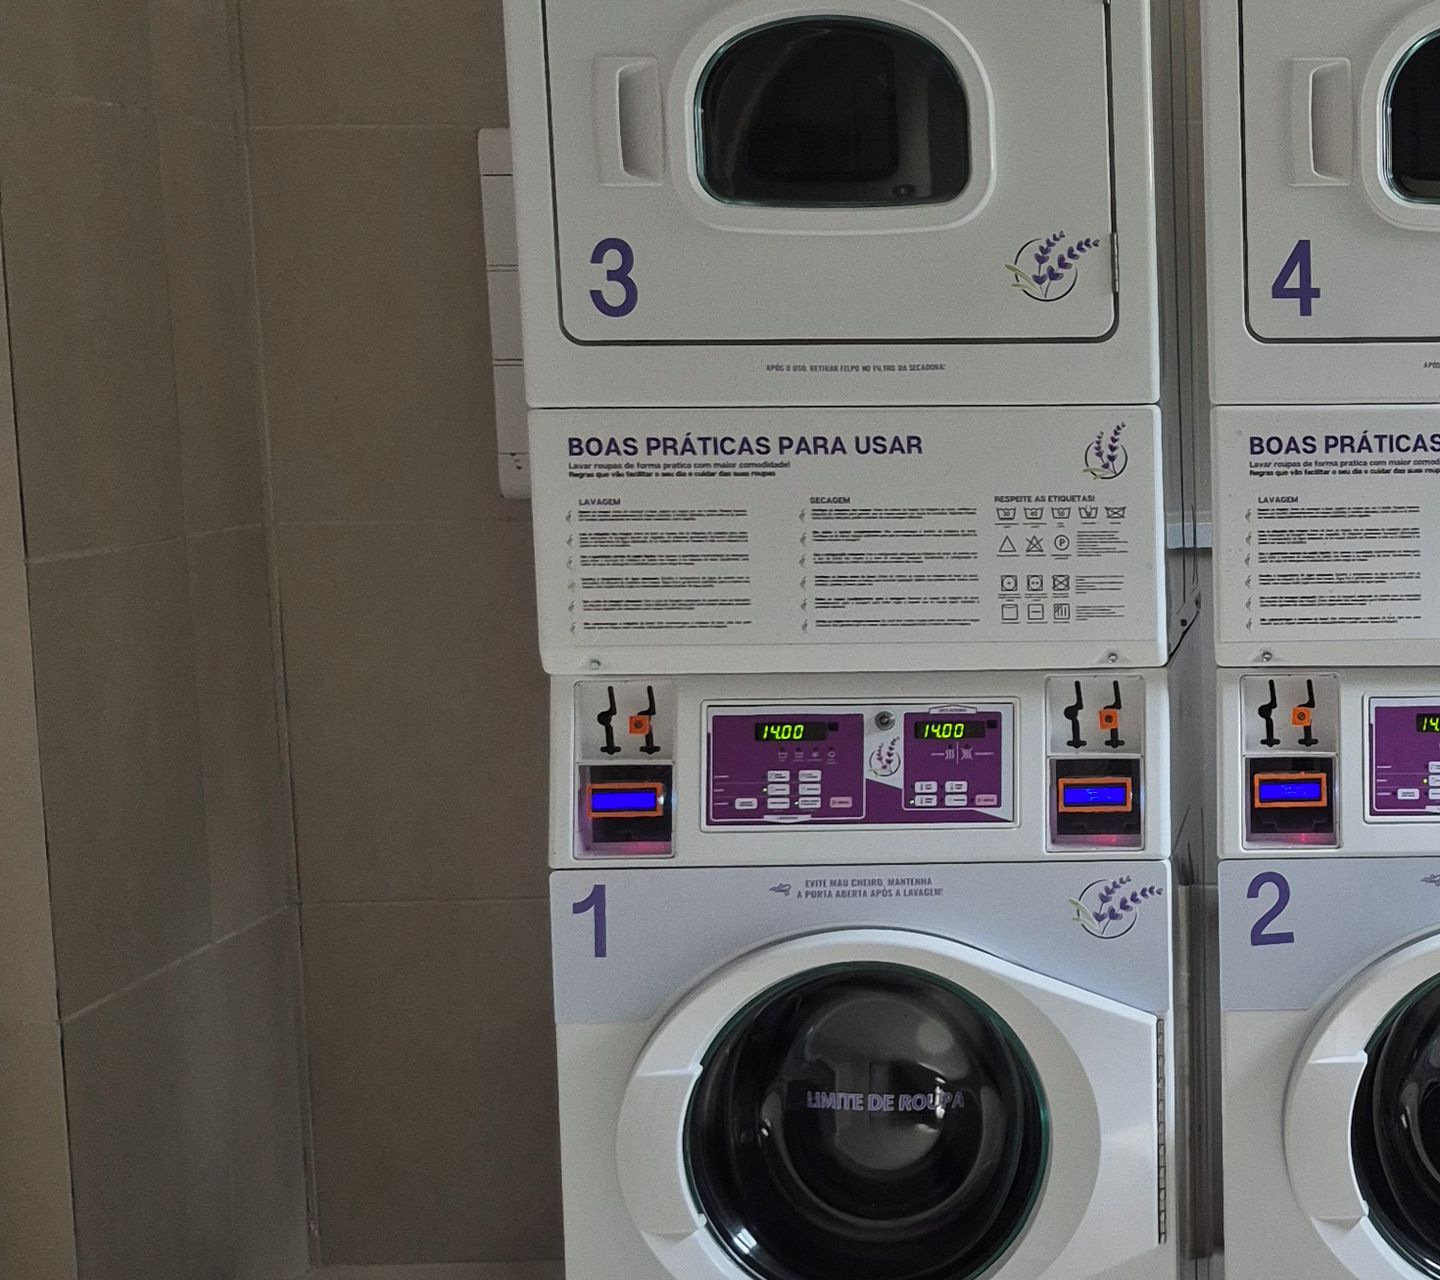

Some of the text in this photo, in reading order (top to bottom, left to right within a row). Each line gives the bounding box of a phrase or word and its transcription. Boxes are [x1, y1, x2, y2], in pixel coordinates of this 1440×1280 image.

[589, 237, 638, 317] 3
[1271, 239, 1320, 316] 4
[568, 432, 923, 457] BOAS PRÁTICAS PARA USAR
[1250, 435, 1317, 455] BOAS
[1274, 461, 1301, 469] roupas
[579, 498, 621, 506] LAVAGEM
[810, 496, 851, 504] SECAGEM
[1258, 496, 1298, 504] LAVAGEM
[763, 724, 805, 739] 14.00
[924, 723, 965, 738] 14.00
[805, 879, 827, 888] EVITE
[830, 879, 849, 888] MAU
[888, 878, 932, 886] MANTENHA
[805, 890, 833, 898] PORTA
[835, 890, 868, 898] ABERTA
[870, 887, 893, 897] APÓS
[903, 888, 943, 896] LAVAGEM!
[1247, 871, 1294, 946] 2
[572, 884, 606, 957] 1
[807, 1091, 864, 1111] LIMITE
[867, 1093, 894, 1111] DE
